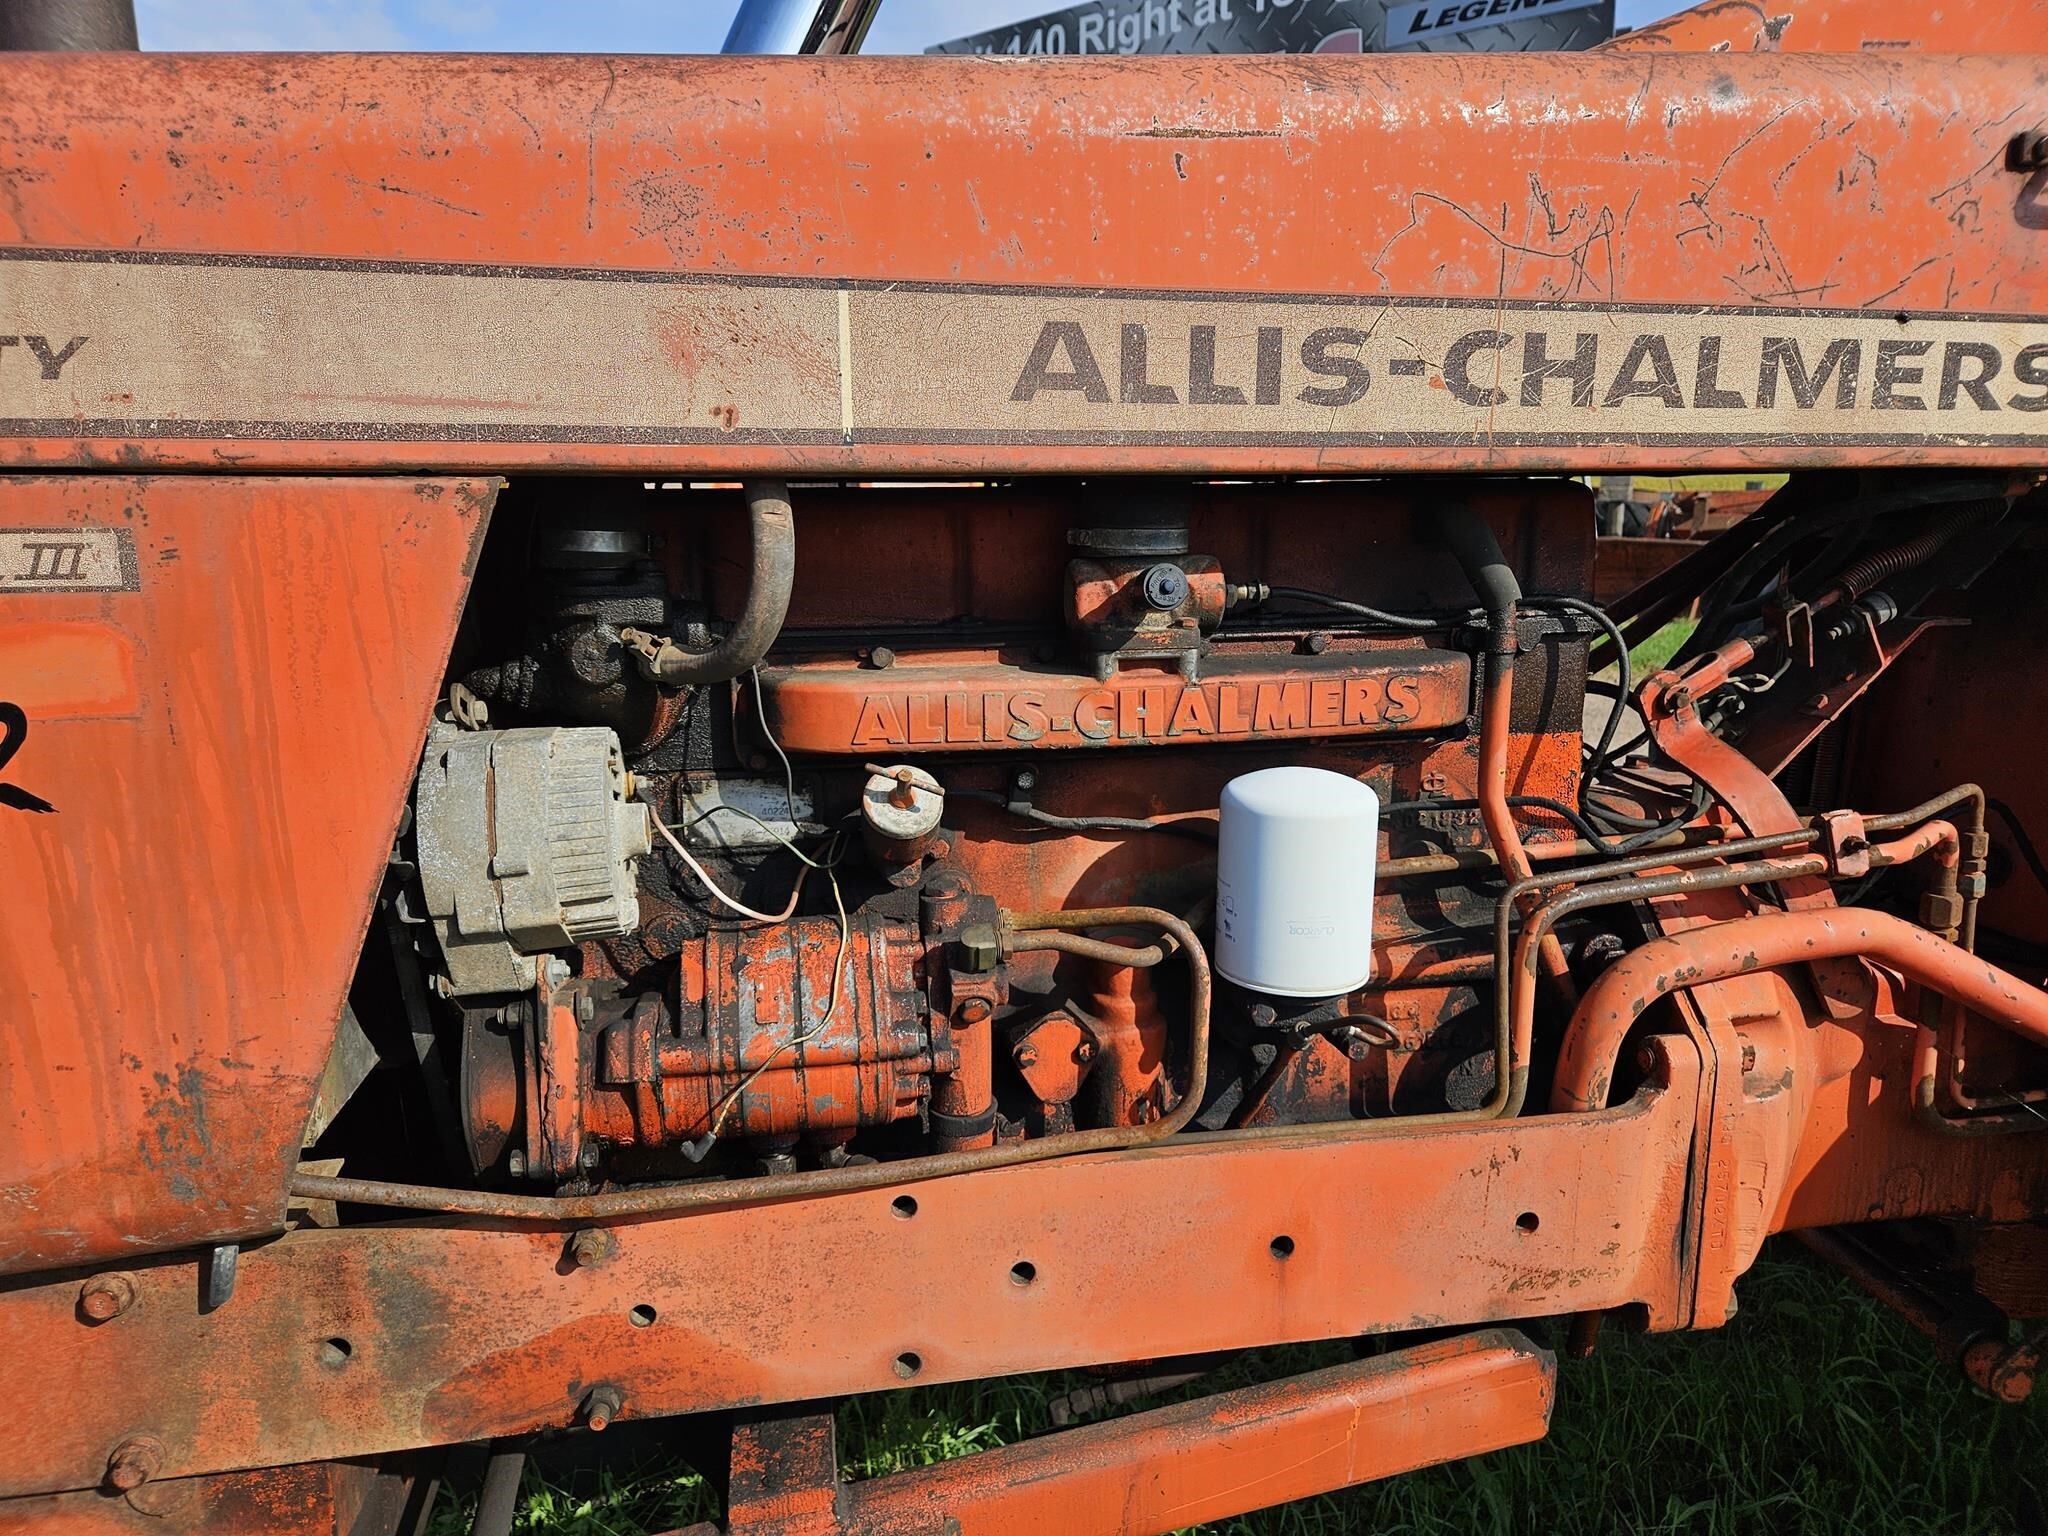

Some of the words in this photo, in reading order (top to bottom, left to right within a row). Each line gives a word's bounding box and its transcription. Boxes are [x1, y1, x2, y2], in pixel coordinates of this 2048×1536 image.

[1079, 0, 1183, 54] Right
[1408, 0, 1562, 34] LEGE
[0, 336, 89, 380] Y
[1010, 320, 2048, 412] ALLIS-CHALMERS
[852, 675, 1421, 747] ALLIS-CHALMERS
